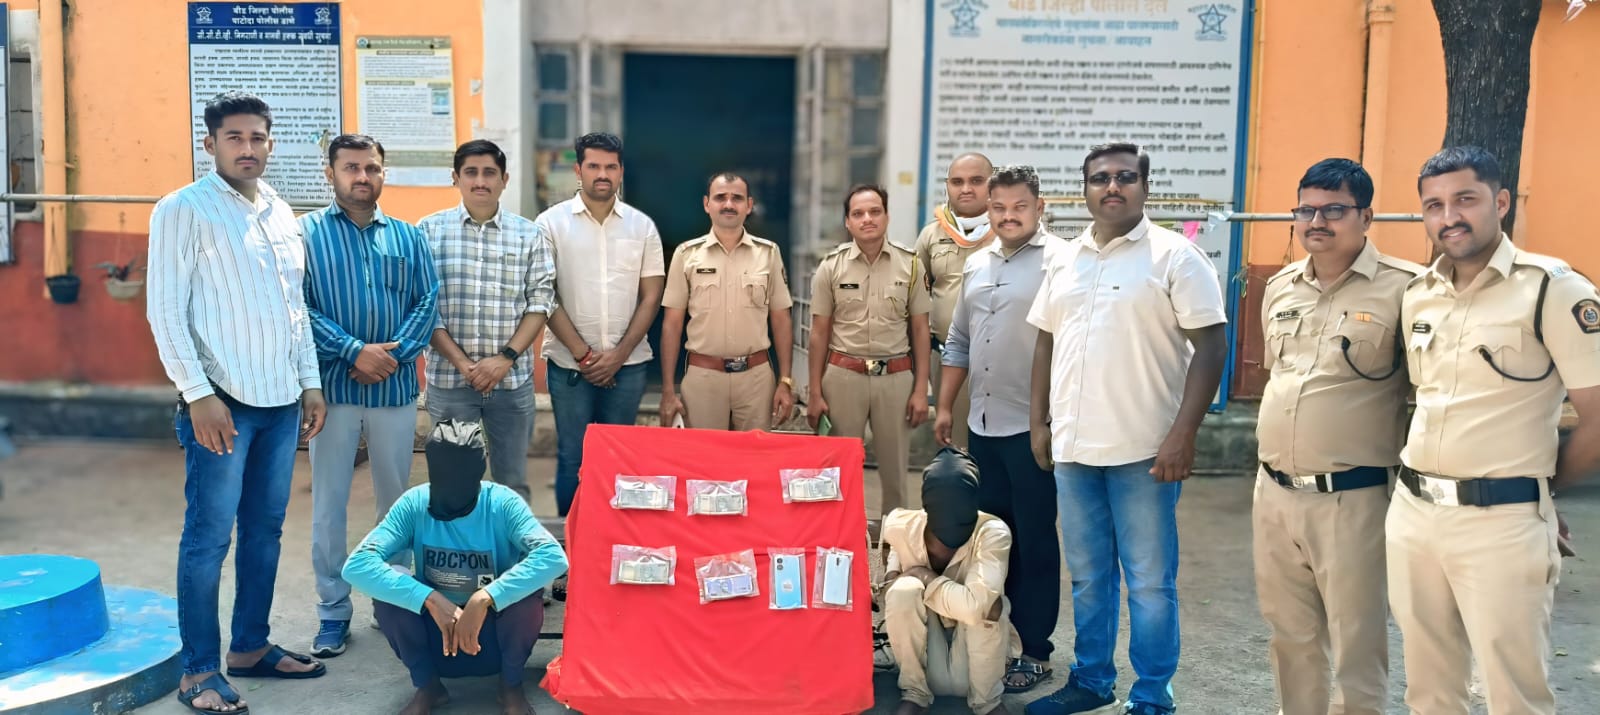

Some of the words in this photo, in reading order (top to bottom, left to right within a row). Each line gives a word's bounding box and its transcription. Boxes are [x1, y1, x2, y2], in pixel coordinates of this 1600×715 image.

[248, 5, 269, 15] जिल्हा
[271, 5, 294, 14] पोलीस
[232, 16, 255, 25] पाटोदा
[256, 16, 279, 25] पोलीस
